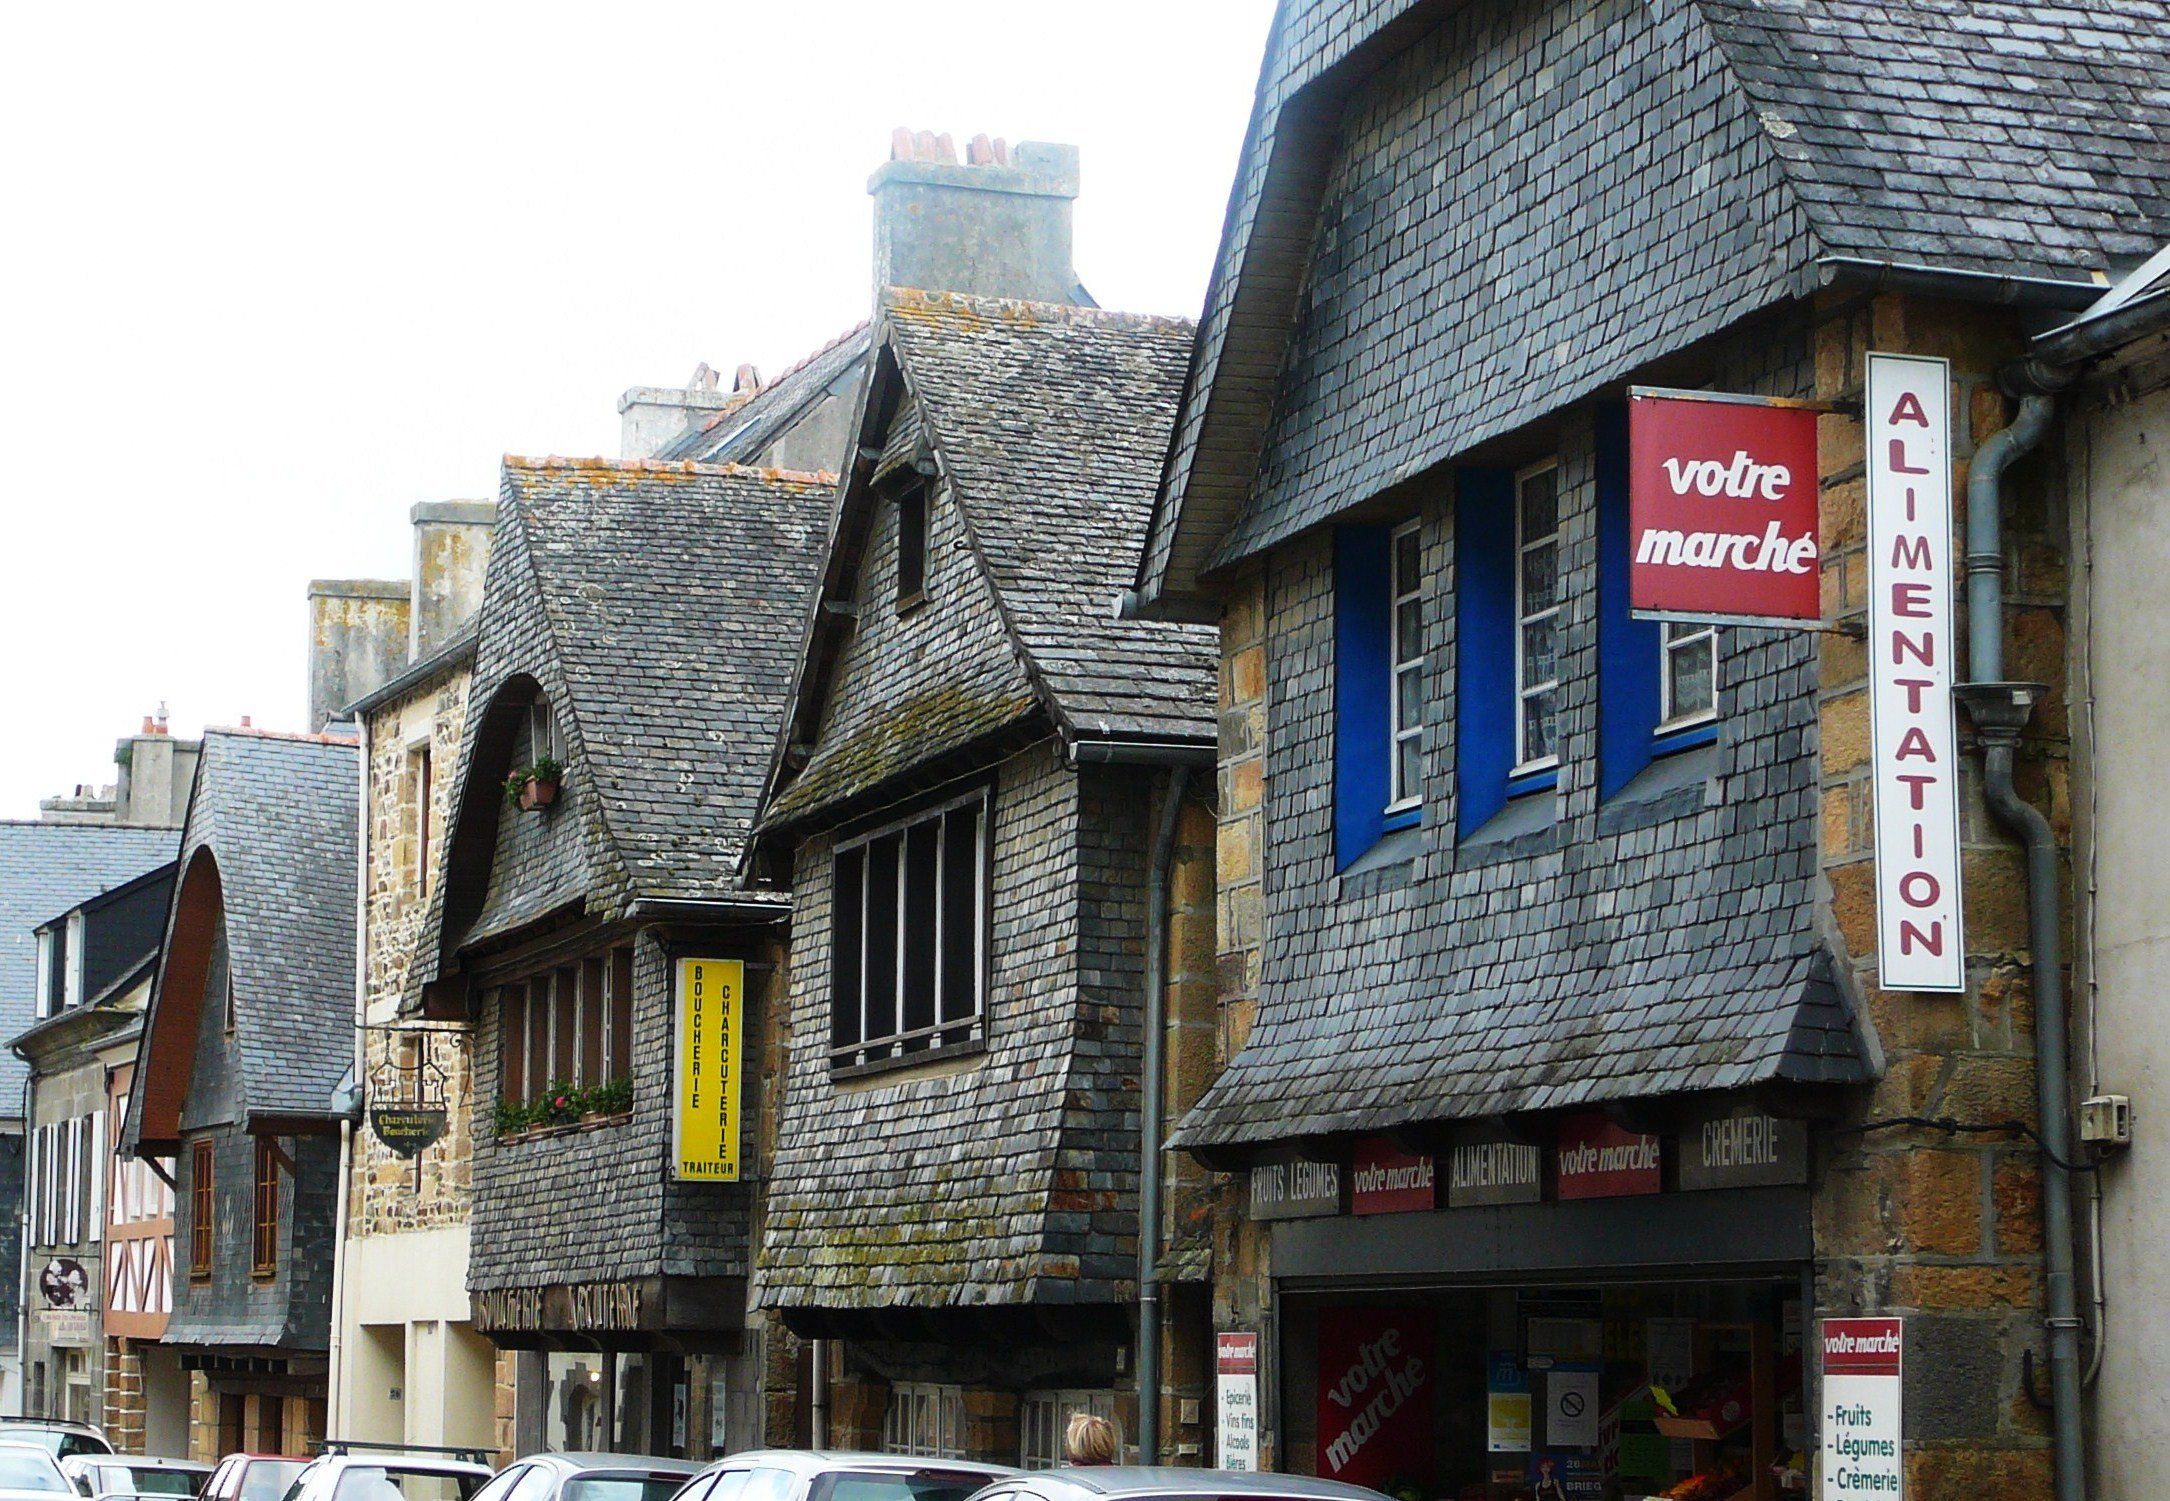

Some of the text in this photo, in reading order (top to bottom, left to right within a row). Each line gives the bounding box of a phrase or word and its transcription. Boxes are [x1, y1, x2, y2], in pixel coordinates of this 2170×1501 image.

[1662, 450, 1791, 501] votre
[1635, 520, 1818, 575] marché
[1887, 391, 1943, 957] ALIMENTATION
[691, 965, 703, 1109] BOUCHERIE
[718, 985, 731, 1160] CHARCUTERIE
[1559, 1133, 1660, 1176] votre marché
[1702, 1115, 1778, 1168] CREMERIE
[682, 1161, 734, 1175] TRAITEUR
[1251, 1161, 1338, 1203] FRUITS LEGUMES
[1353, 1156, 1435, 1194] votre marché
[1451, 1142, 1537, 1188] ALIMENTATION
[1824, 1328, 1900, 1354] votre marché
[1327, 1327, 1401, 1408] votre
[1225, 1412, 1255, 1430] Vins fins
[1835, 1403, 1872, 1427] Fruits
[1226, 1435, 1250, 1450] Alcools
[1836, 1431, 1895, 1462] Légumes
